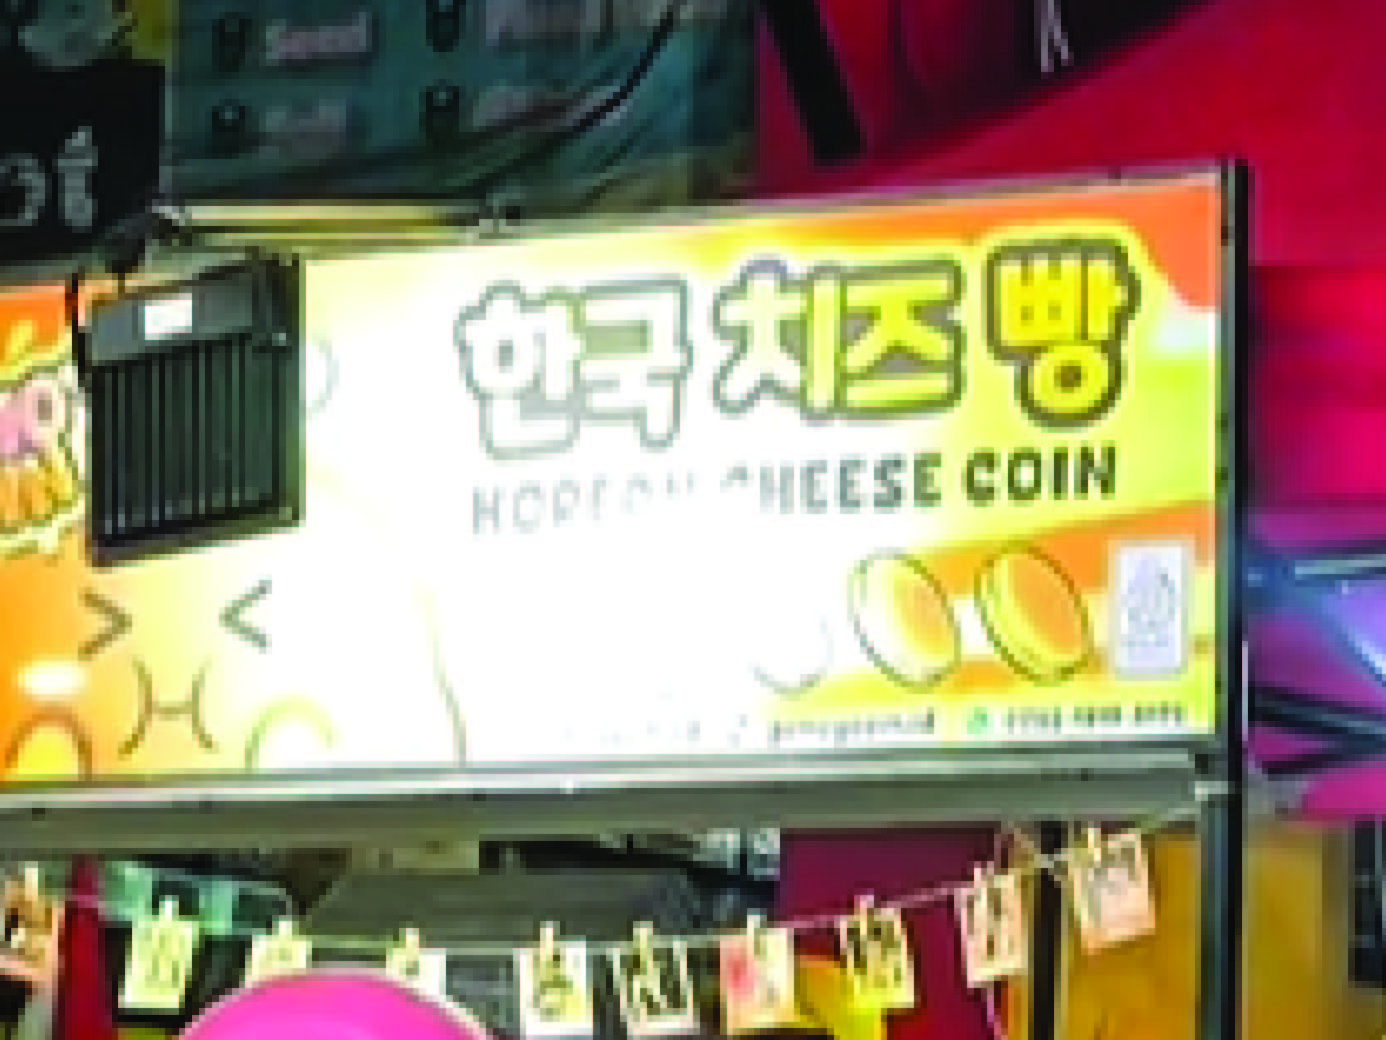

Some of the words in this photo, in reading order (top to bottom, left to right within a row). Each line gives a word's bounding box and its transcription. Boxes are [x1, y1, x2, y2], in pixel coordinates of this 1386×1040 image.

[455, 274, 693, 460] 한국
[710, 254, 965, 426] 치즈
[985, 236, 1142, 431] 빵
[471, 473, 697, 535] KORE
[964, 444, 1118, 510] COIN
